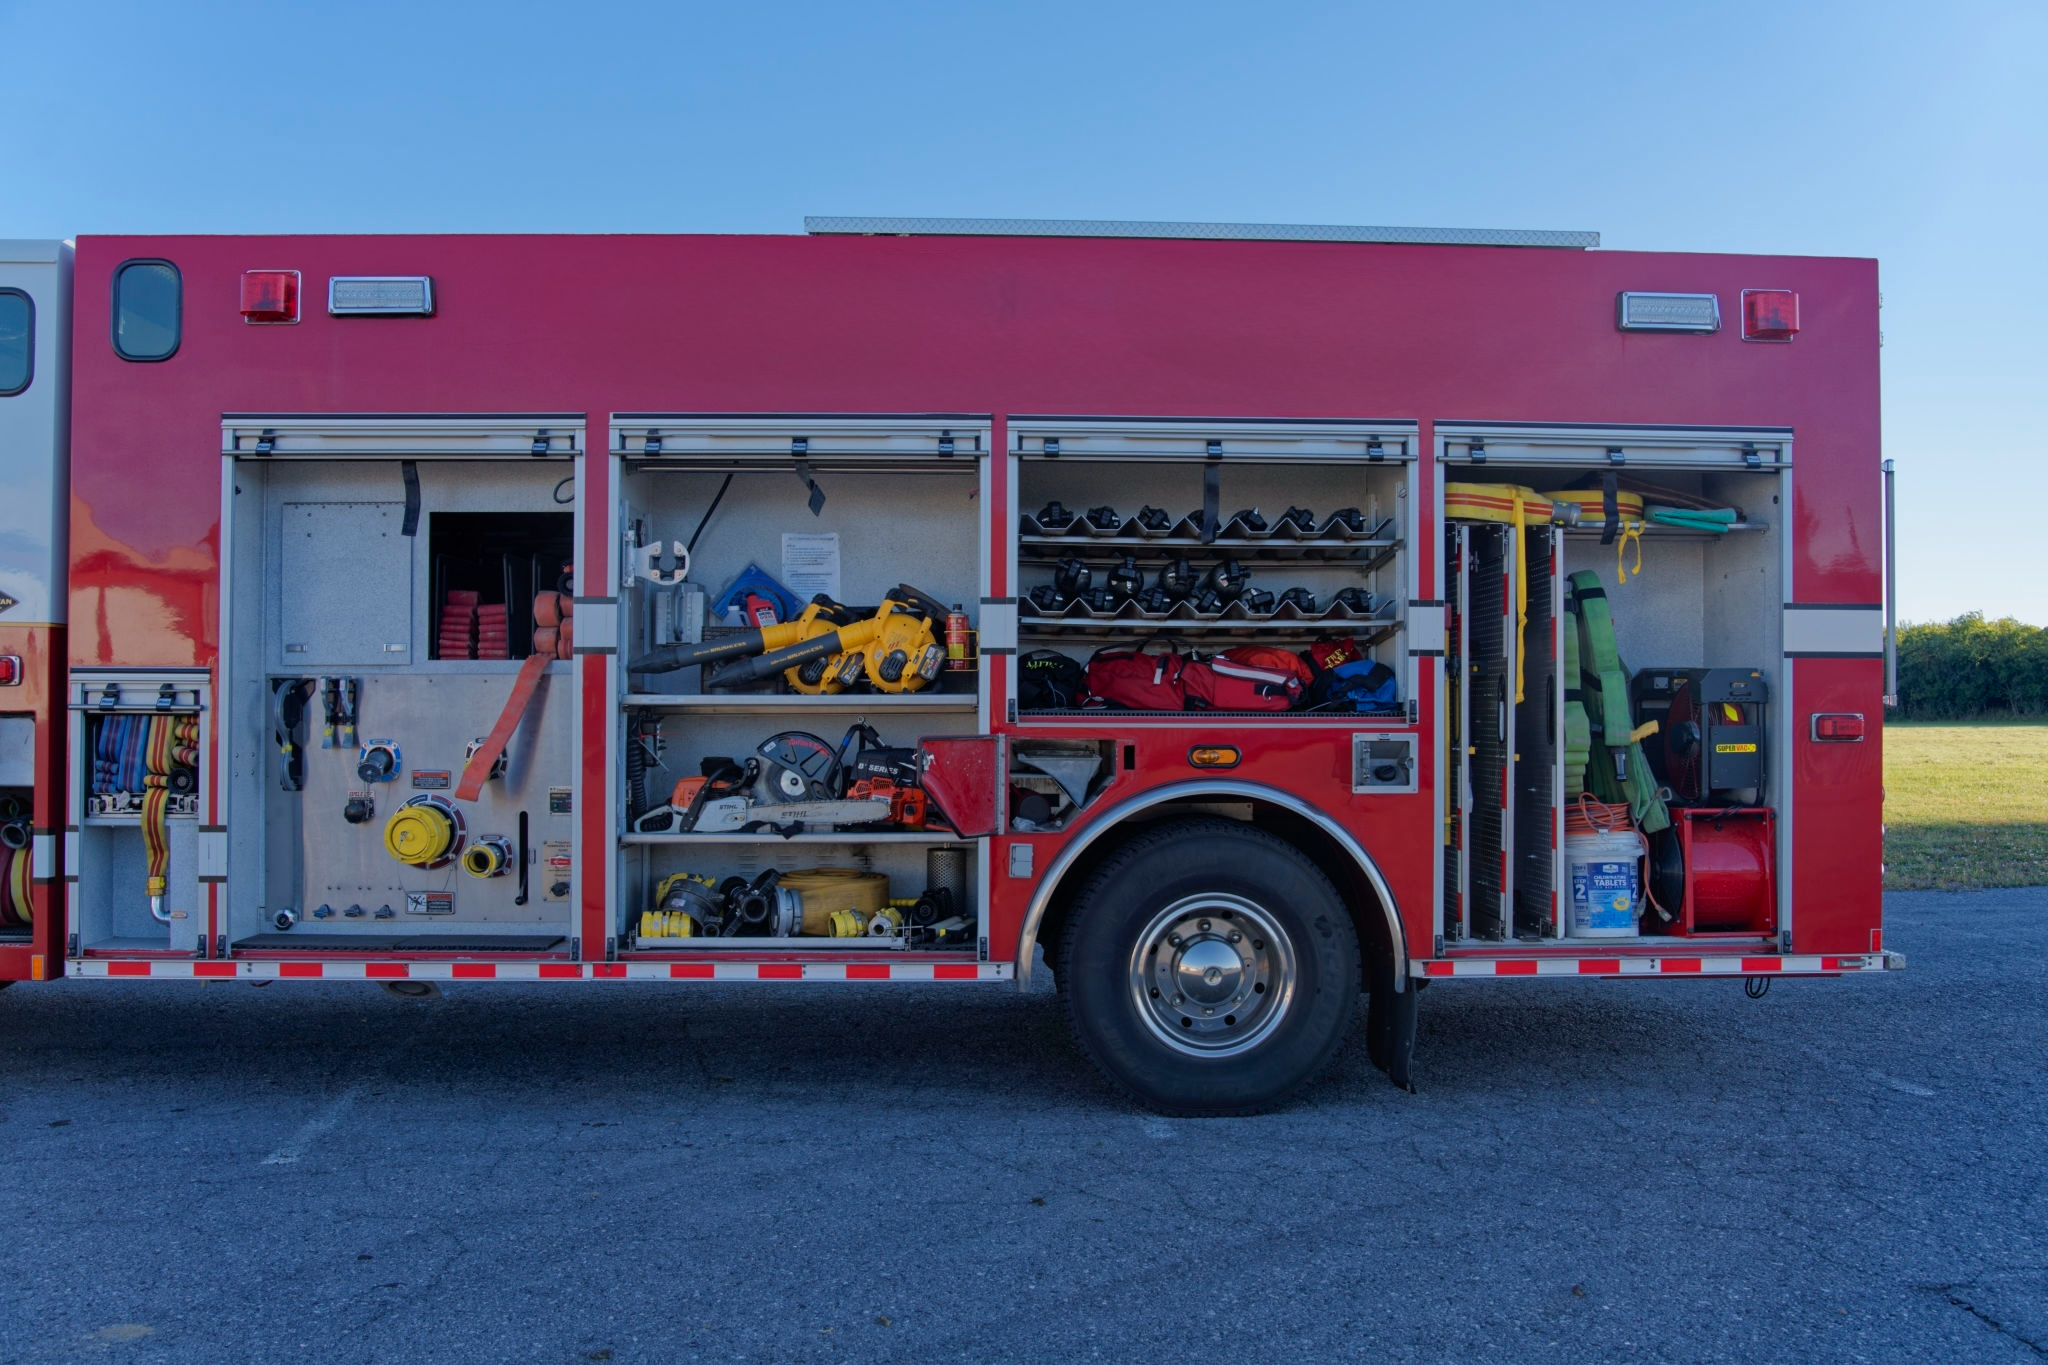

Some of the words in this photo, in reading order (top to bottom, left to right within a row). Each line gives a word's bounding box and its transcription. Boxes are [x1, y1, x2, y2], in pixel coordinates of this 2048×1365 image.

[868, 764, 899, 775] SERIES
[782, 810, 808, 819] STIHL
[1575, 884, 1586, 900] 2
[1632, 884, 1637, 898] 2
